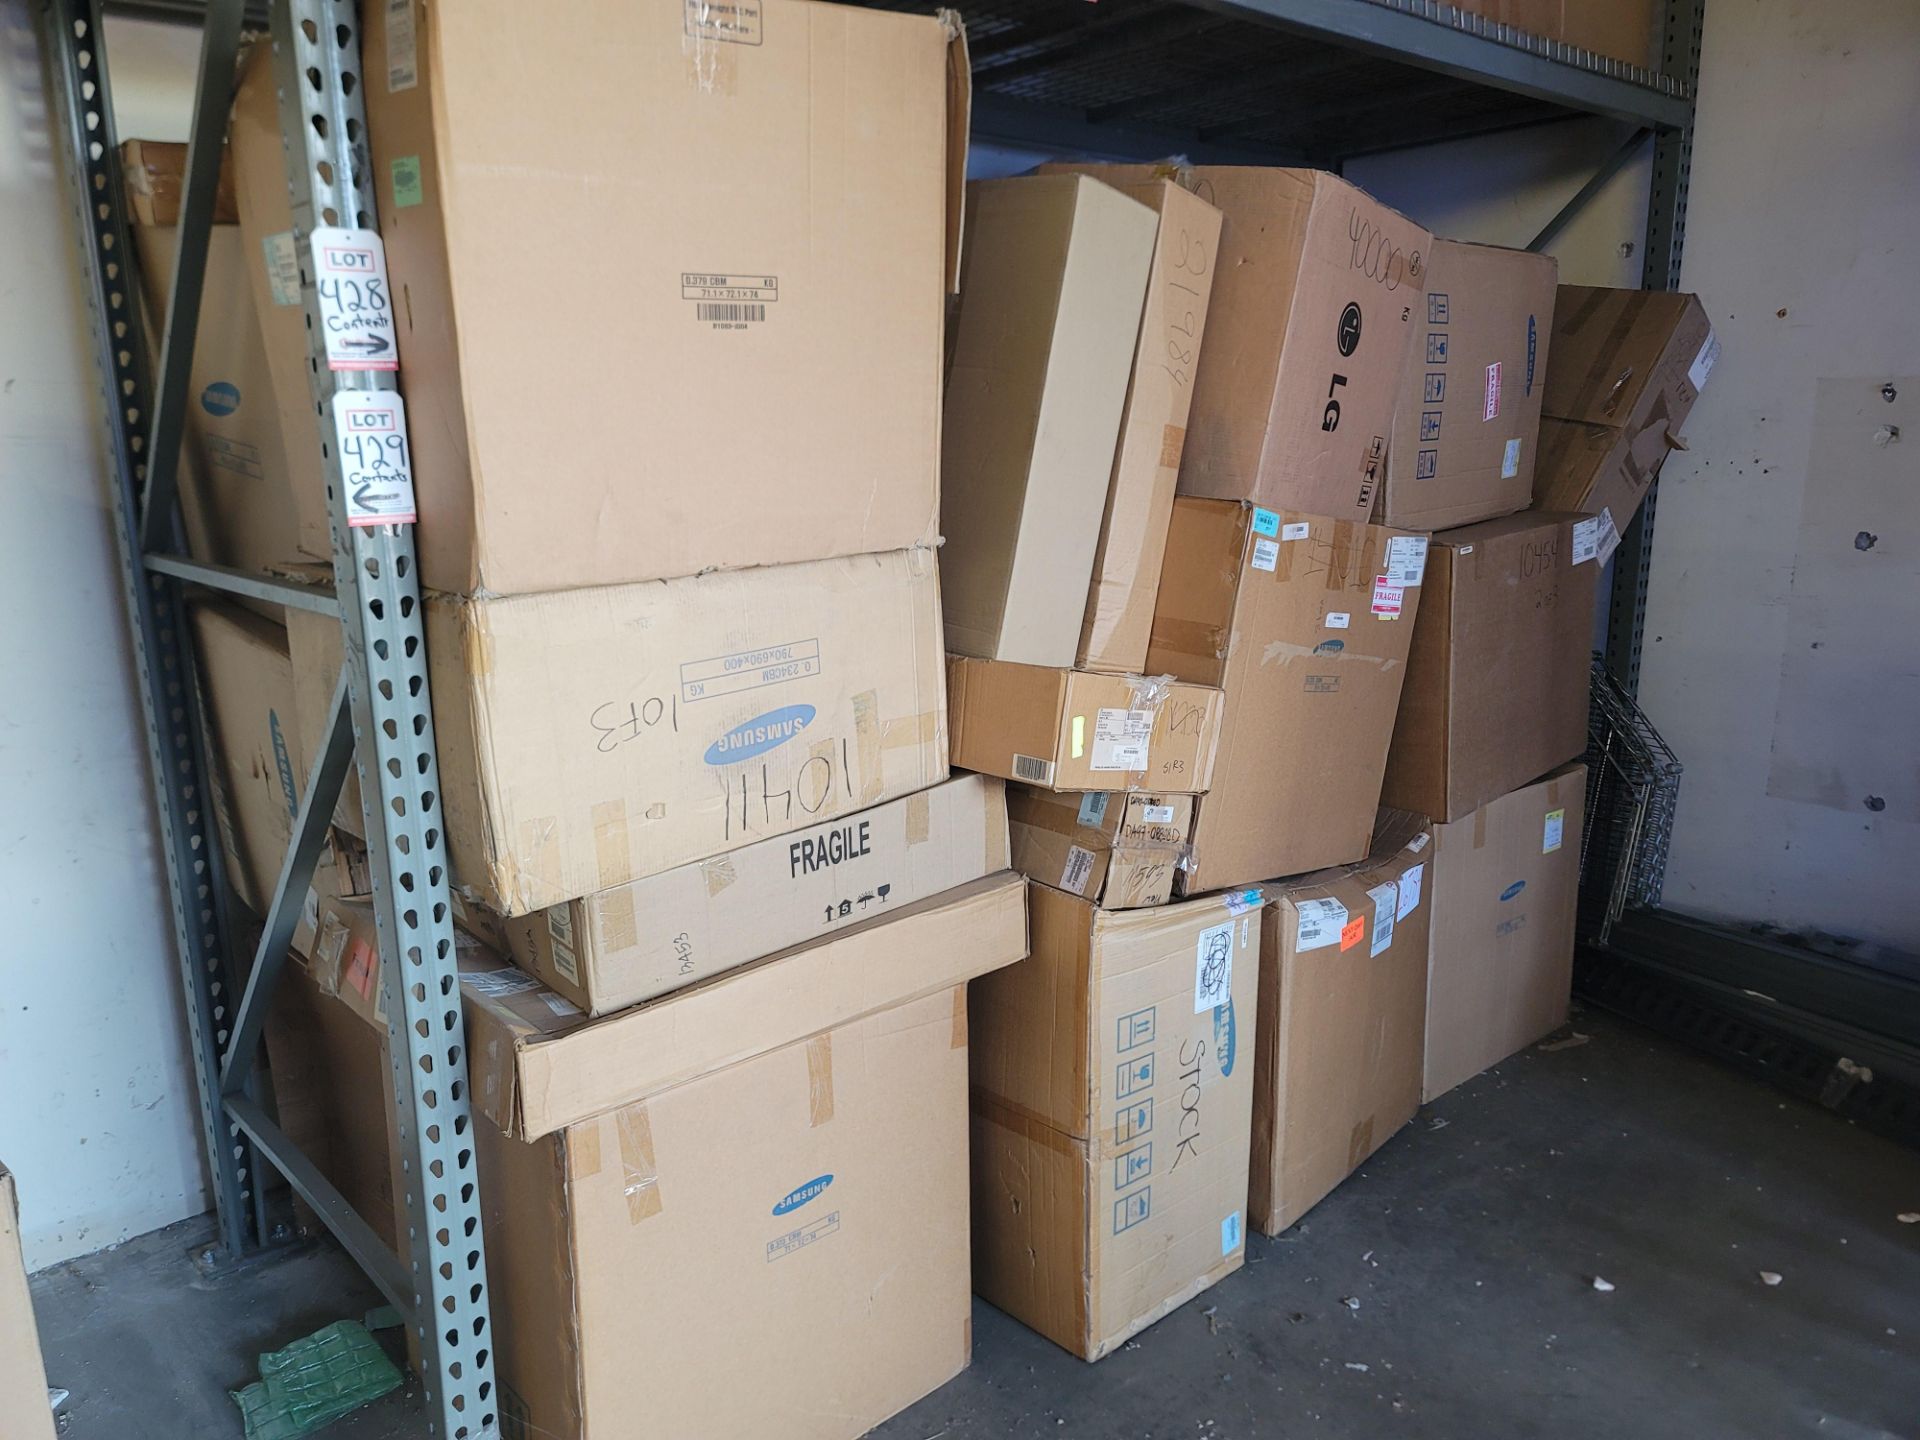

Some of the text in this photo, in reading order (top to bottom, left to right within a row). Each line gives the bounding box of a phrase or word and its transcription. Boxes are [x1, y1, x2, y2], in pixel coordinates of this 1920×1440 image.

[331, 252, 368, 267] LOT
[320, 278, 386, 313] 428
[709, 277, 727, 286] CBM
[1162, 229, 1206, 386] 21984
[1322, 373, 1347, 432] LG
[352, 414, 388, 427] LOT
[344, 434, 407, 470] 429
[1375, 591, 1401, 602] FRAGILE
[690, 682, 705, 697] KG
[718, 717, 804, 752] SAMSUNG
[726, 738, 852, 841] 10411
[789, 821, 871, 878] FRAGILE
[1169, 1038, 1206, 1175] STOCK
[779, 1181, 828, 1208] SAMSUNG
